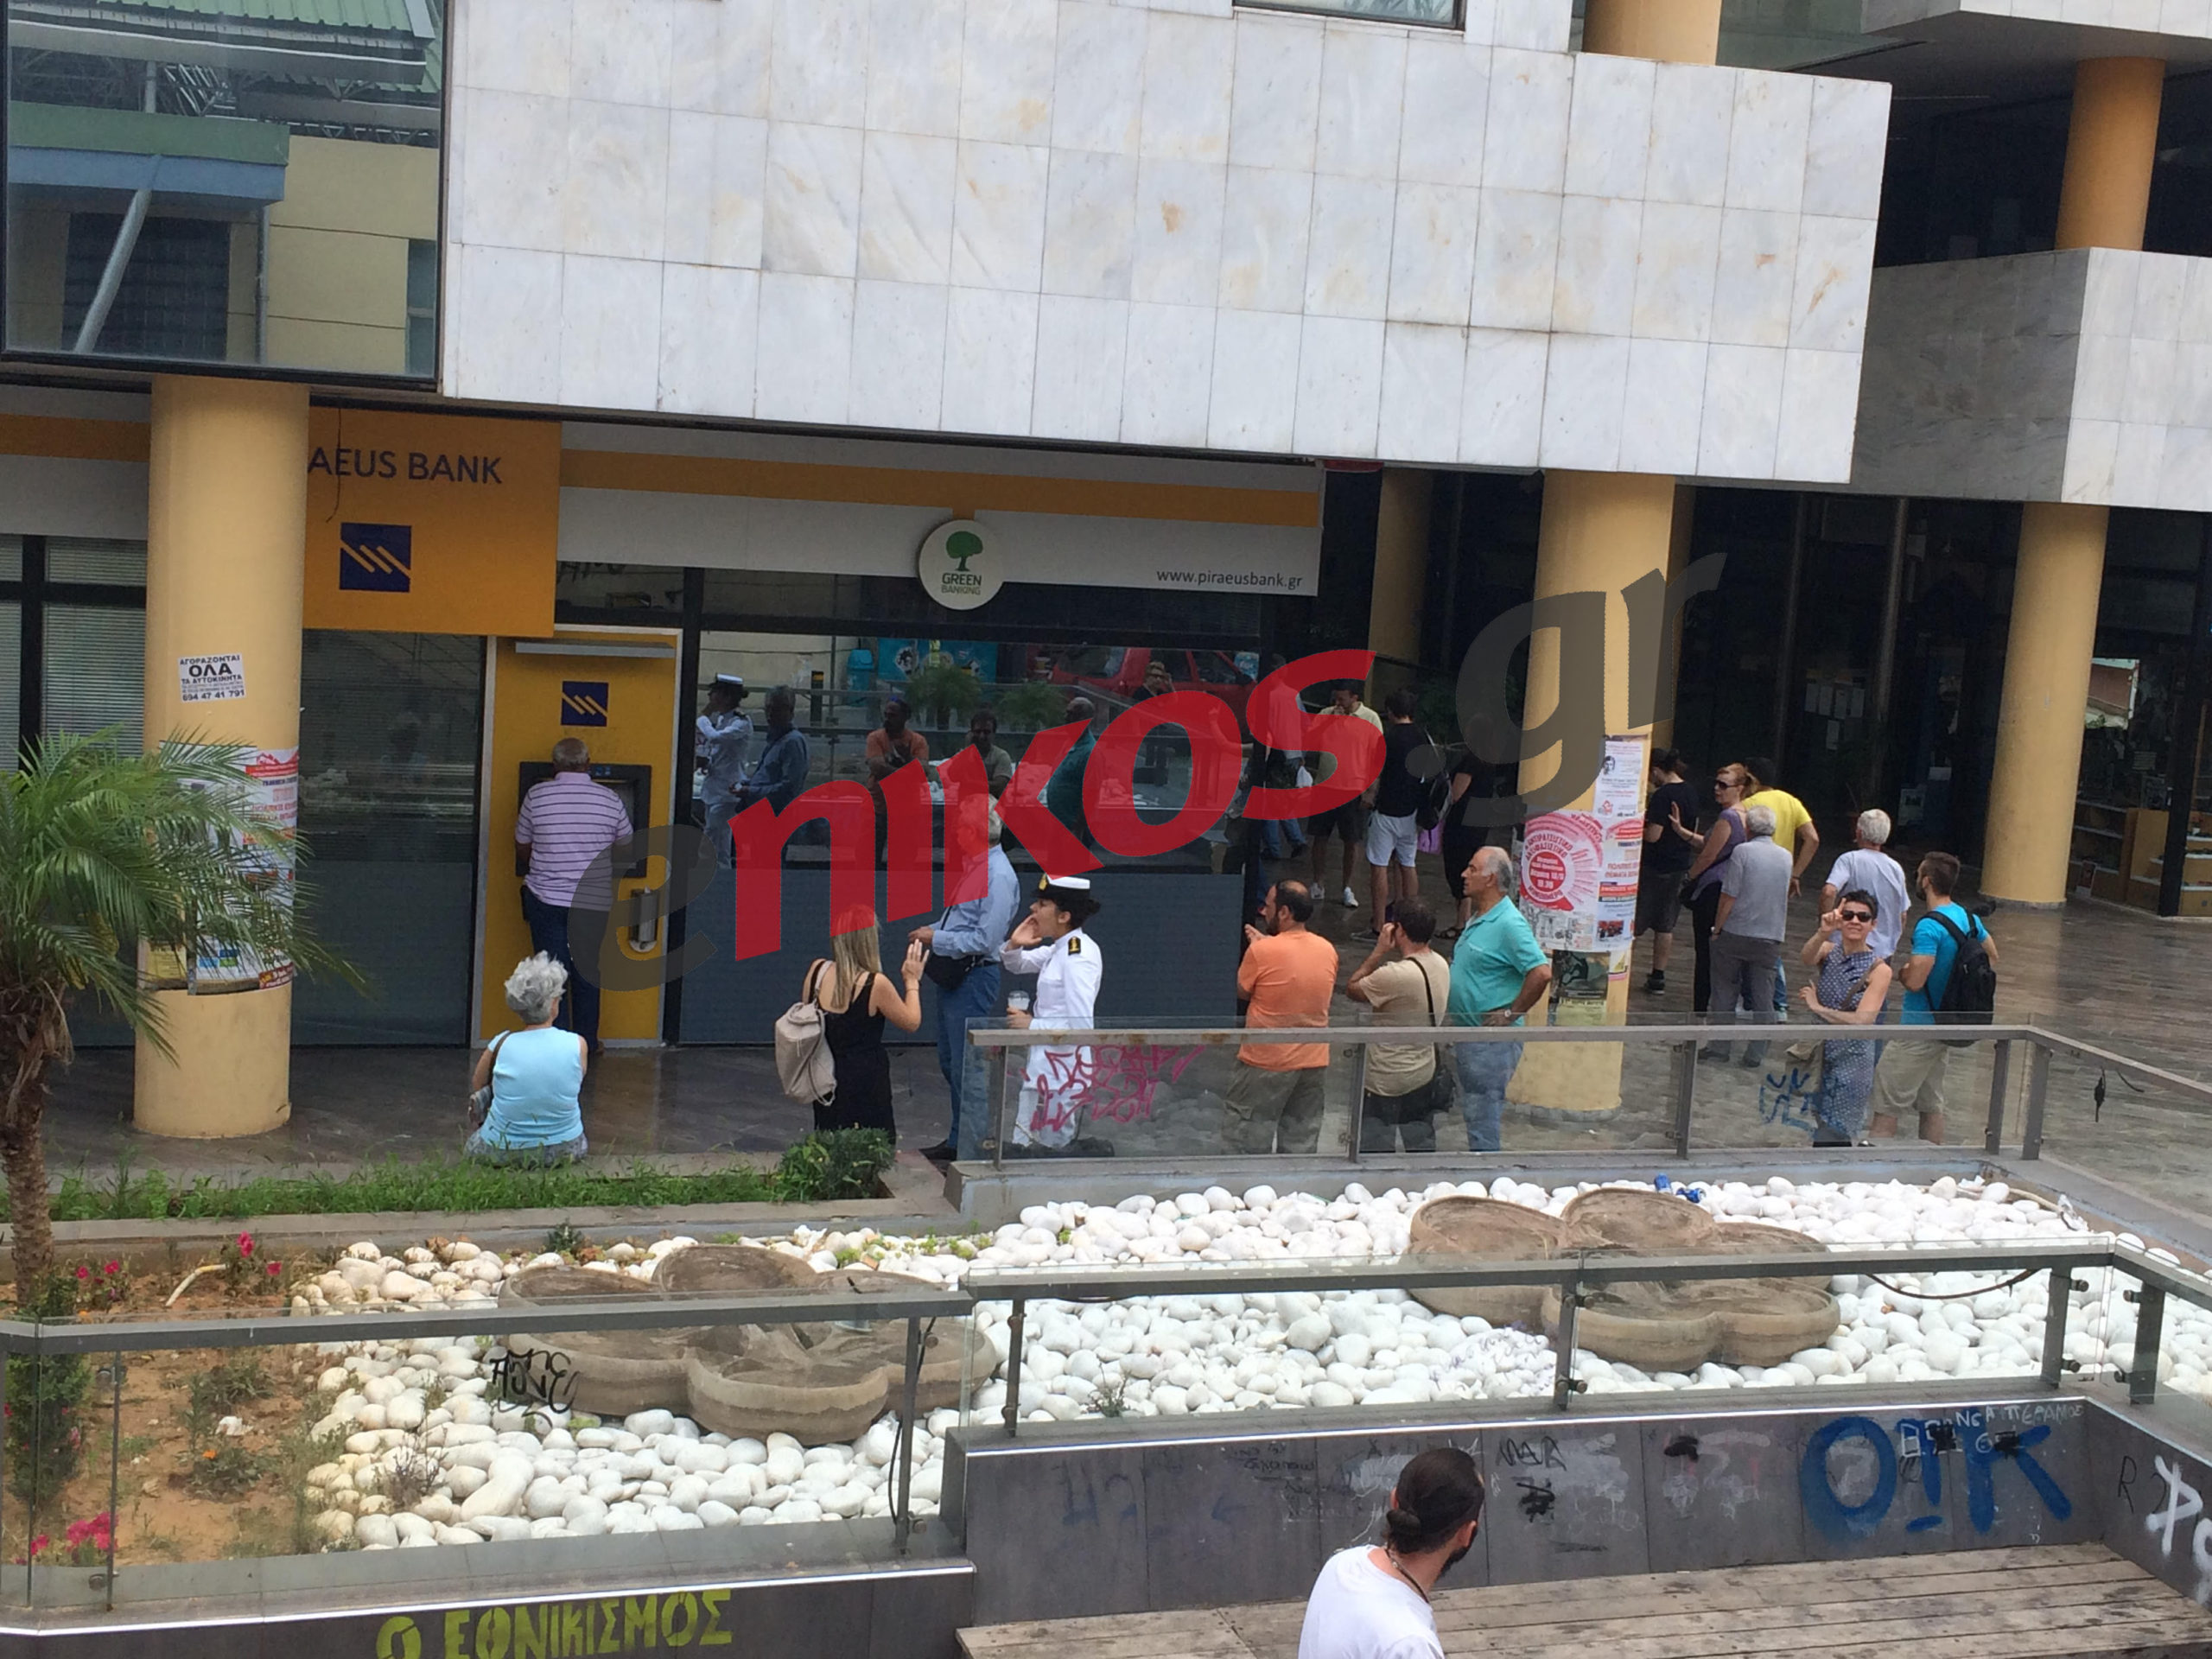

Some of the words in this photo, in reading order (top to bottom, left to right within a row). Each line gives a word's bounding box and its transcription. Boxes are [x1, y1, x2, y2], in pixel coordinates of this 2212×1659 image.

[408, 452, 503, 484] BANK
[942, 573, 982, 586] GREEN
[1156, 570, 1303, 590] www.piraeusbank.gr
[941, 585, 981, 595] BANKING
[180, 655, 240, 665] ΑΓΟΡΑΖΟΝΤΑΙ
[188, 663, 232, 677] ΟΛΑ
[376, 1616, 422, 1659] Ο
[444, 1588, 734, 1659] ΕΘΝΙΚΙΣΜΟΣ
